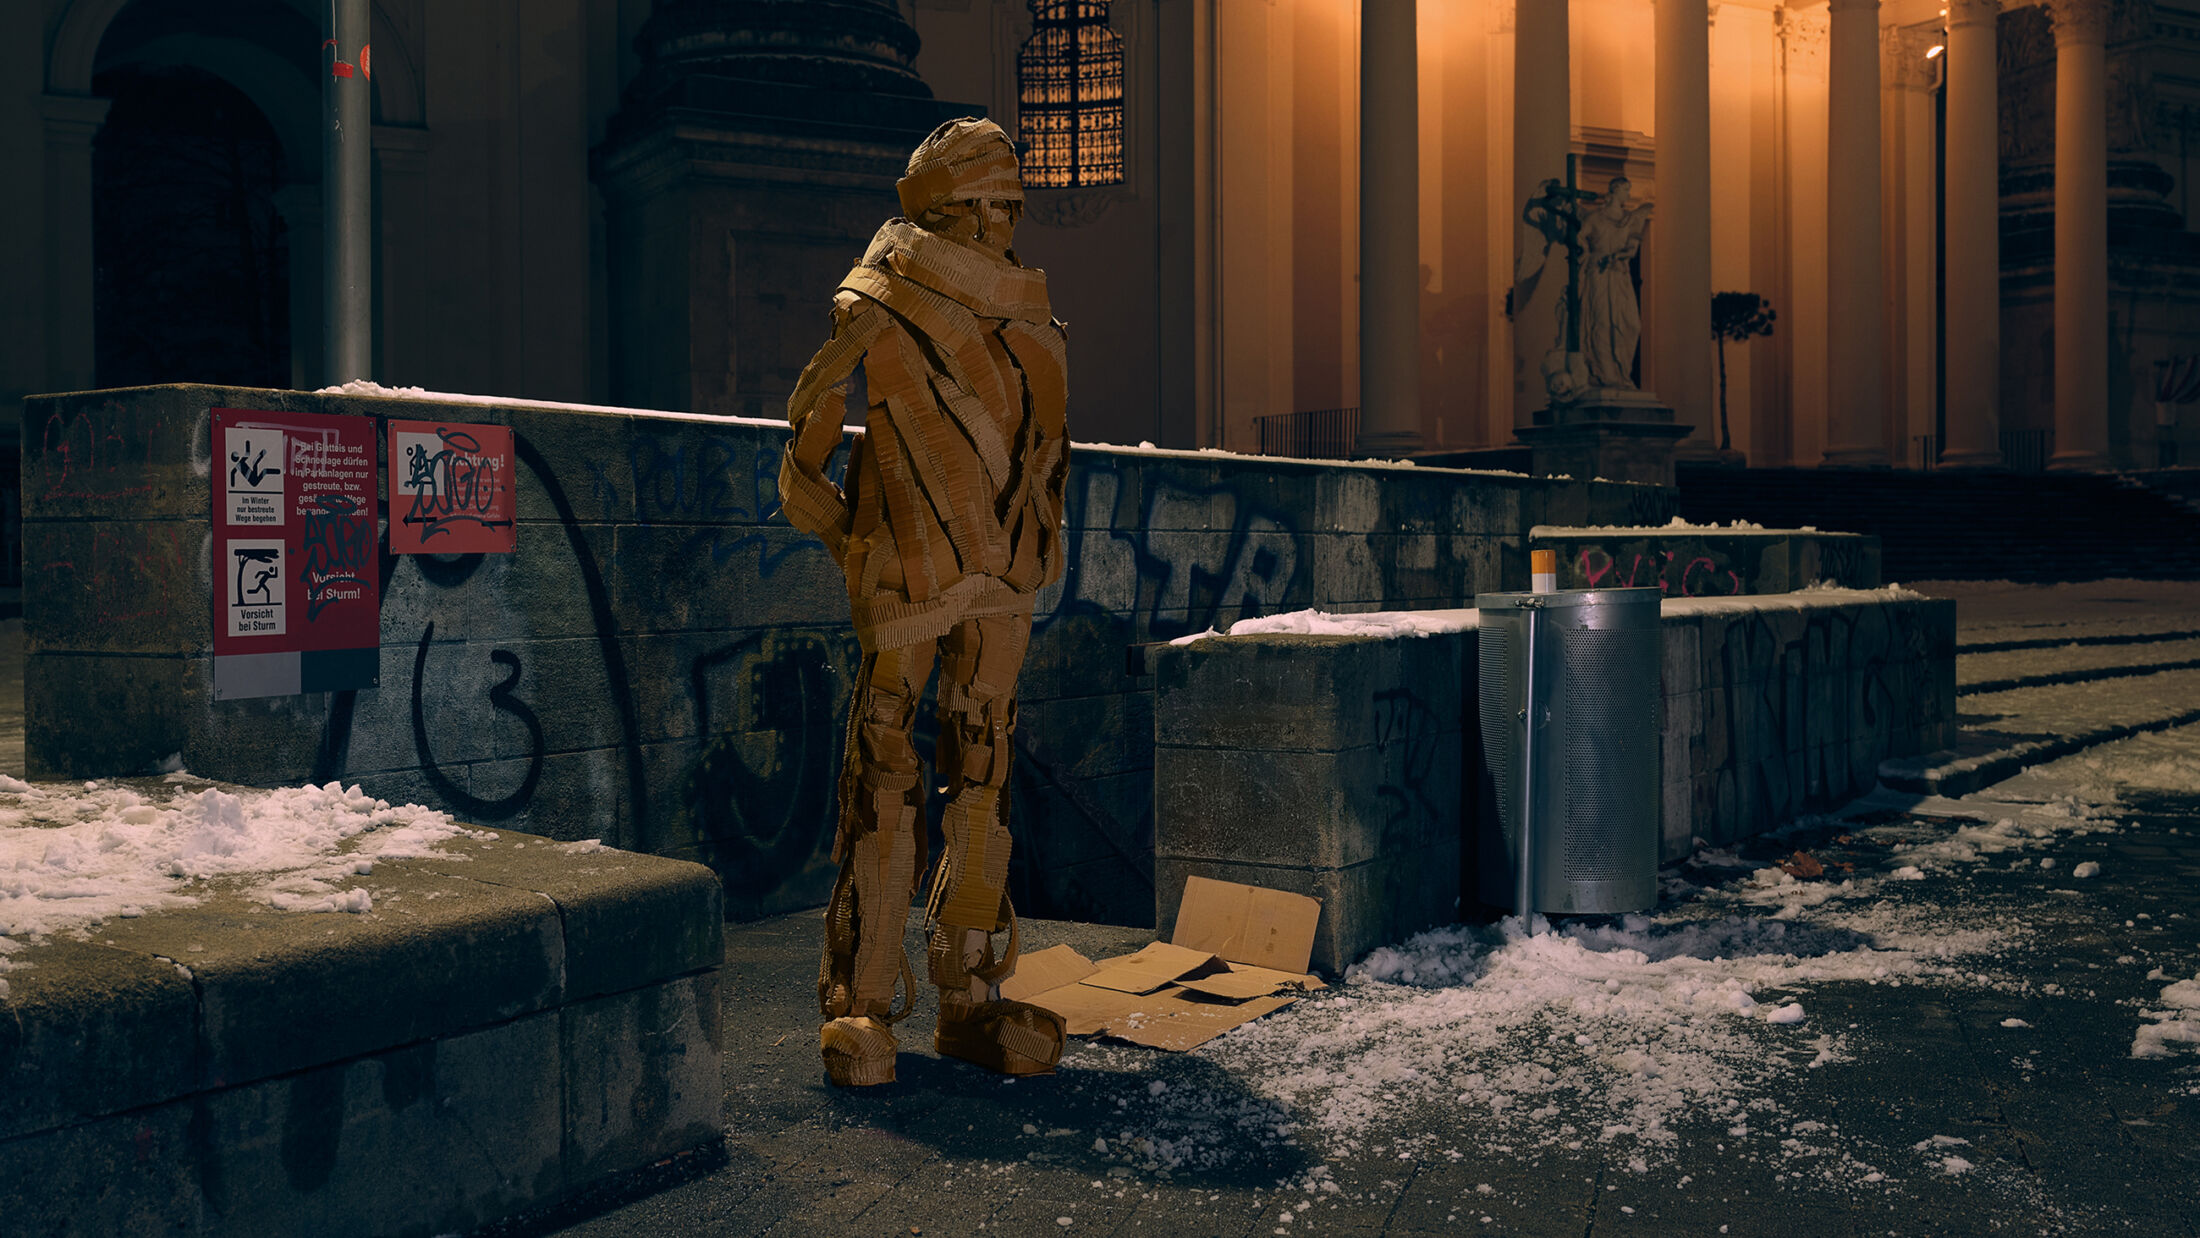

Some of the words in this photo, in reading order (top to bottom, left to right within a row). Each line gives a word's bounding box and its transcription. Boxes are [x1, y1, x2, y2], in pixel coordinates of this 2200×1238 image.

[348, 444, 363, 453] und
[343, 456, 368, 466] dürfen
[305, 468, 353, 480] Parkanlagen
[303, 482, 342, 492] gestreute,
[344, 482, 362, 491] bzw.
[235, 514, 251, 523] Wege
[252, 514, 277, 523] begehen
[326, 587, 361, 600] Sturm!
[240, 609, 274, 619] Vorsicht
[238, 621, 251, 631] bei
[253, 620, 276, 631] Sturm
